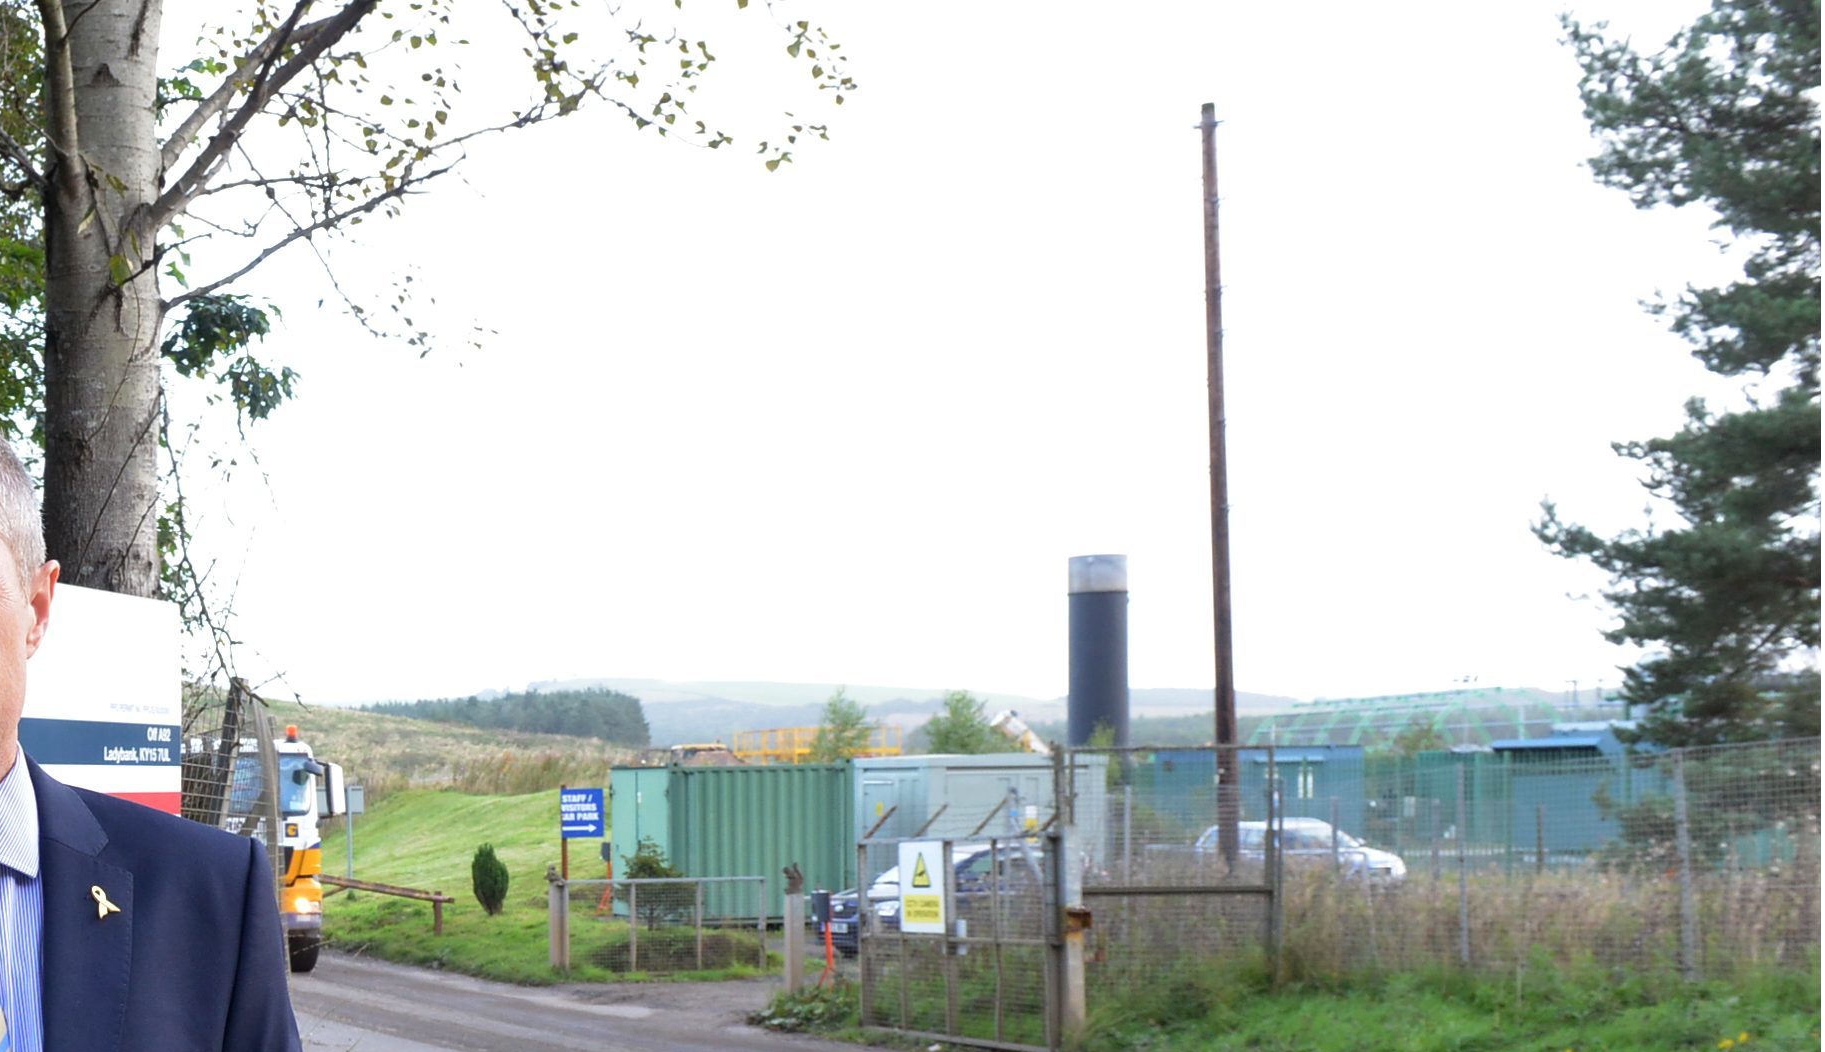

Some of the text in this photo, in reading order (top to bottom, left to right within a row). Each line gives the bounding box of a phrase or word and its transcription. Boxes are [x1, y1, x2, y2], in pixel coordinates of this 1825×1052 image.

[147, 727, 171, 742] Off A92
[104, 746, 171, 764] Ladybank, KY15 7UL
